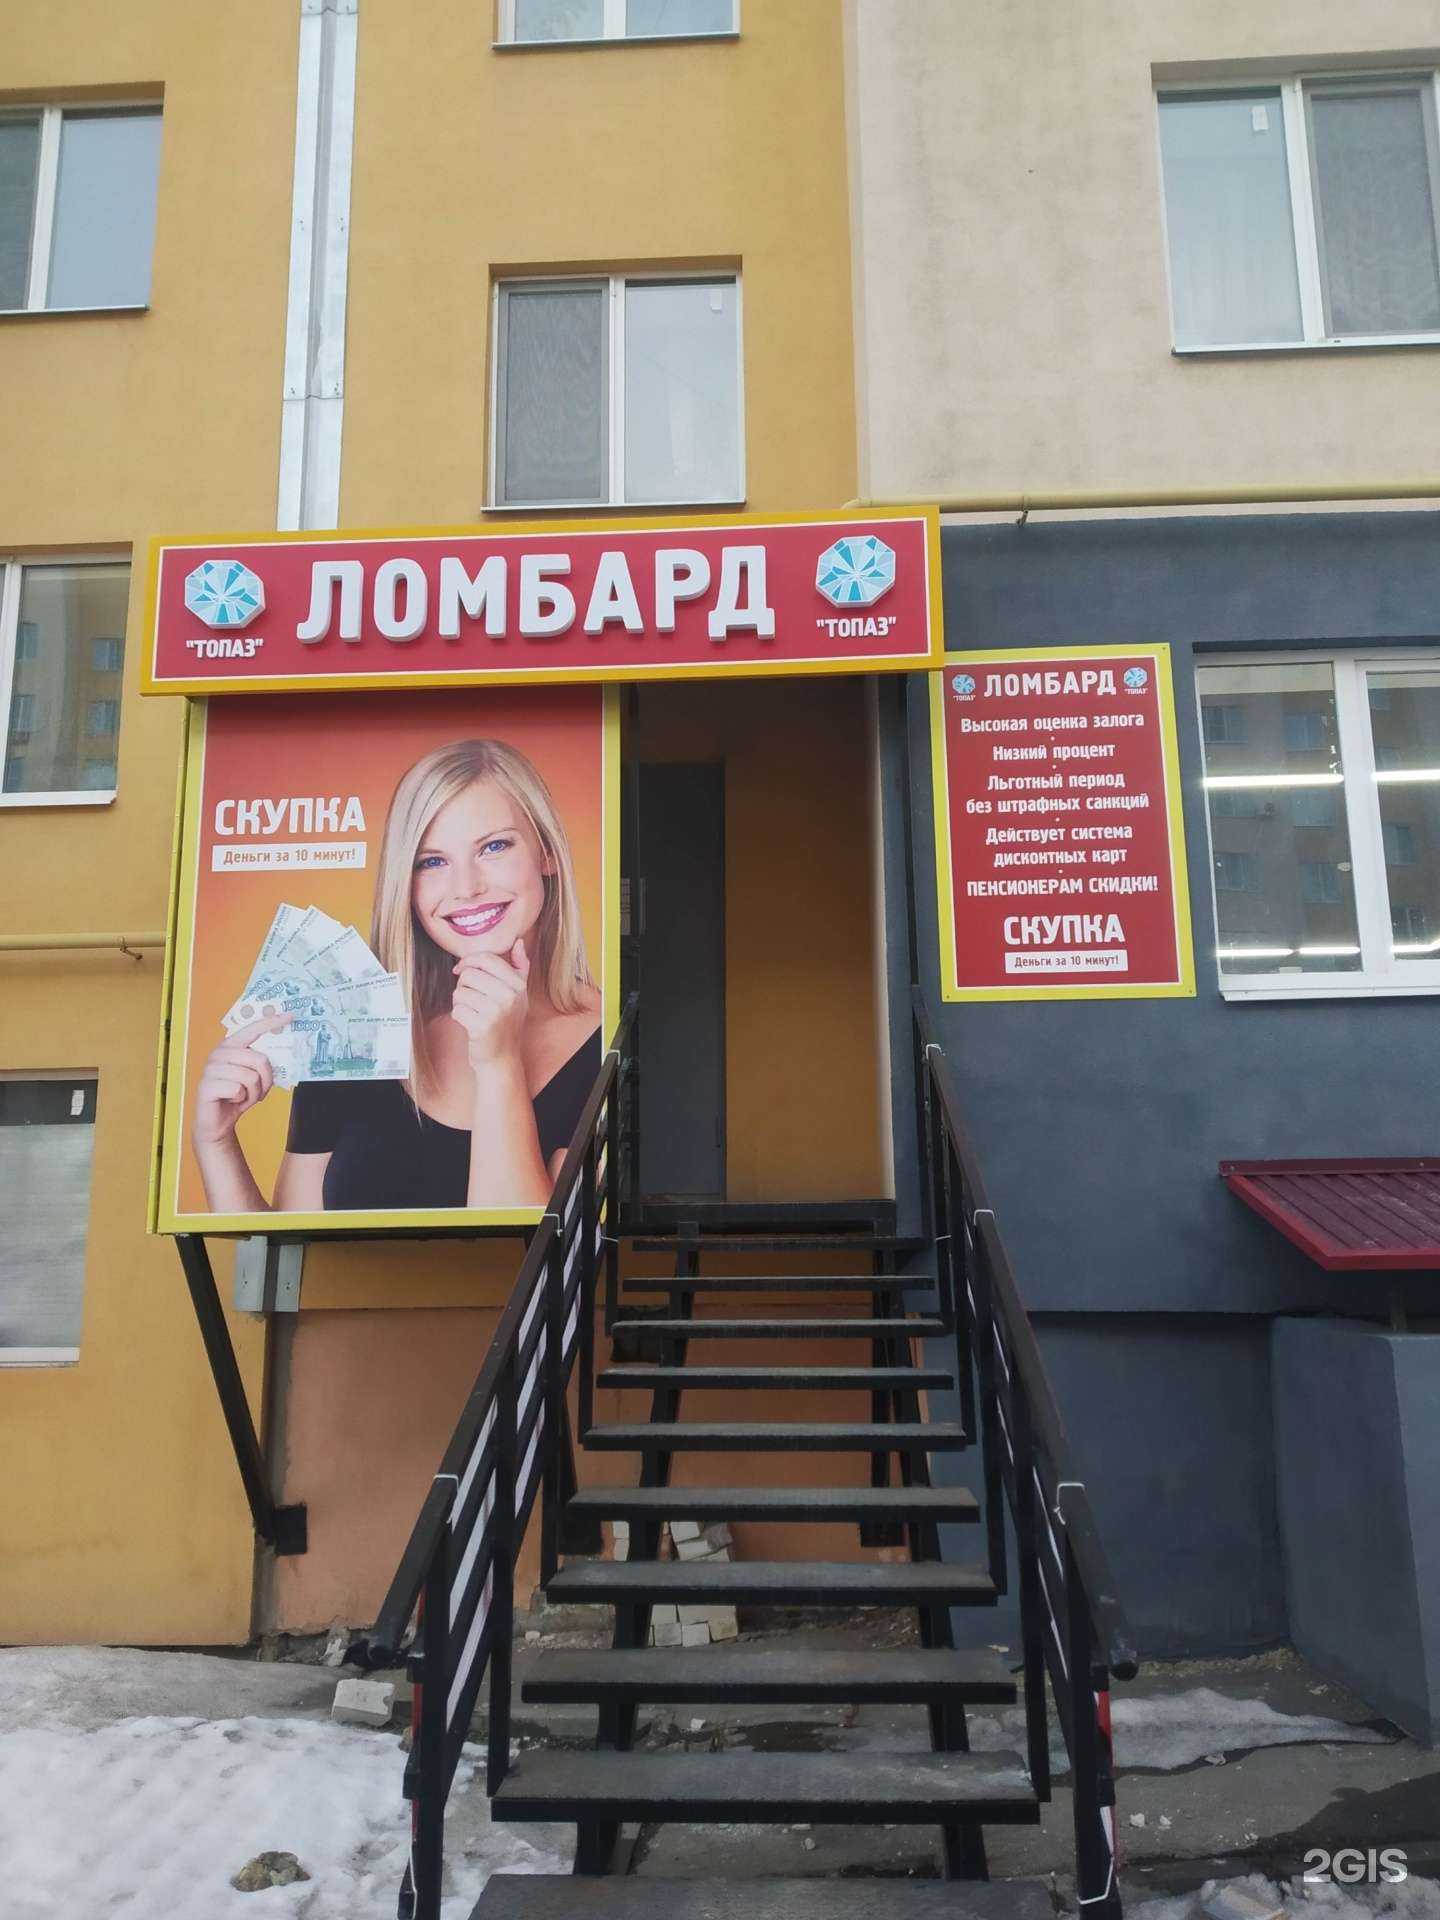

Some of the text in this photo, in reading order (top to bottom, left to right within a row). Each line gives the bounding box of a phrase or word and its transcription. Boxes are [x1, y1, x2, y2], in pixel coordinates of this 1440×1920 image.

[297, 545, 776, 644] ЛОМБАРД
[815, 615, 897, 639] "ТОПАЗ"
[185, 637, 264, 658] "ТОПАЗ"
[983, 669, 1117, 697] ЛОМБАРД
[961, 715, 1145, 733] Высокая оценка залога
[993, 744, 1115, 761] Низкий процент
[987, 773, 1125, 790] Льготный период
[966, 795, 1149, 815] без штрафных санкций
[215, 797, 366, 835] СКУПКА
[986, 825, 1133, 845] Действует система
[223, 848, 356, 864] Деньги за 10 минут!
[994, 849, 1127, 867] дисконтных карт
[967, 876, 1158, 896] ПЕНСИОНЕРАМ СКИДКИ!
[1004, 915, 1125, 944] СКУПКА
[1015, 954, 1119, 968] Деньги за 10 минут!
